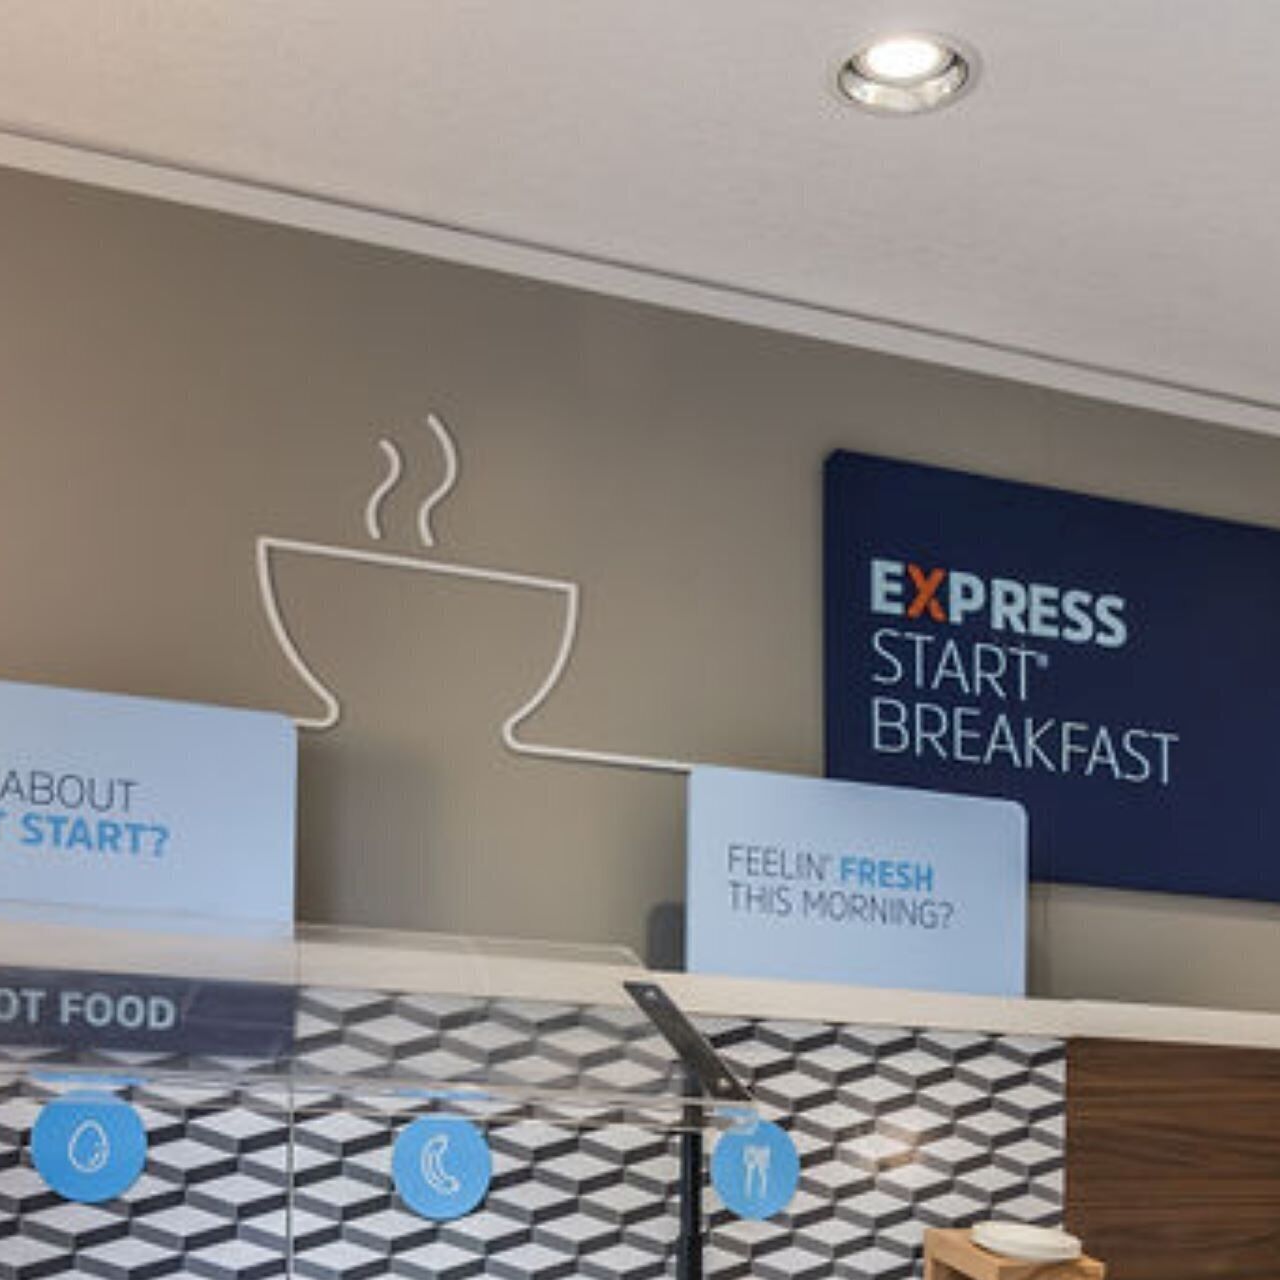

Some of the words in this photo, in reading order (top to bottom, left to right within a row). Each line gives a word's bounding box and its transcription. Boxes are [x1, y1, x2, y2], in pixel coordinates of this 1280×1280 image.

[870, 558, 1128, 649] EXPRESS
[872, 697, 1180, 786] BREAKFAST
[20, 811, 171, 858] START?
[839, 855, 935, 893] FRESH
[728, 879, 794, 918] THIS
[802, 889, 957, 931] MORNING?
[59, 990, 177, 1030] FOOD
